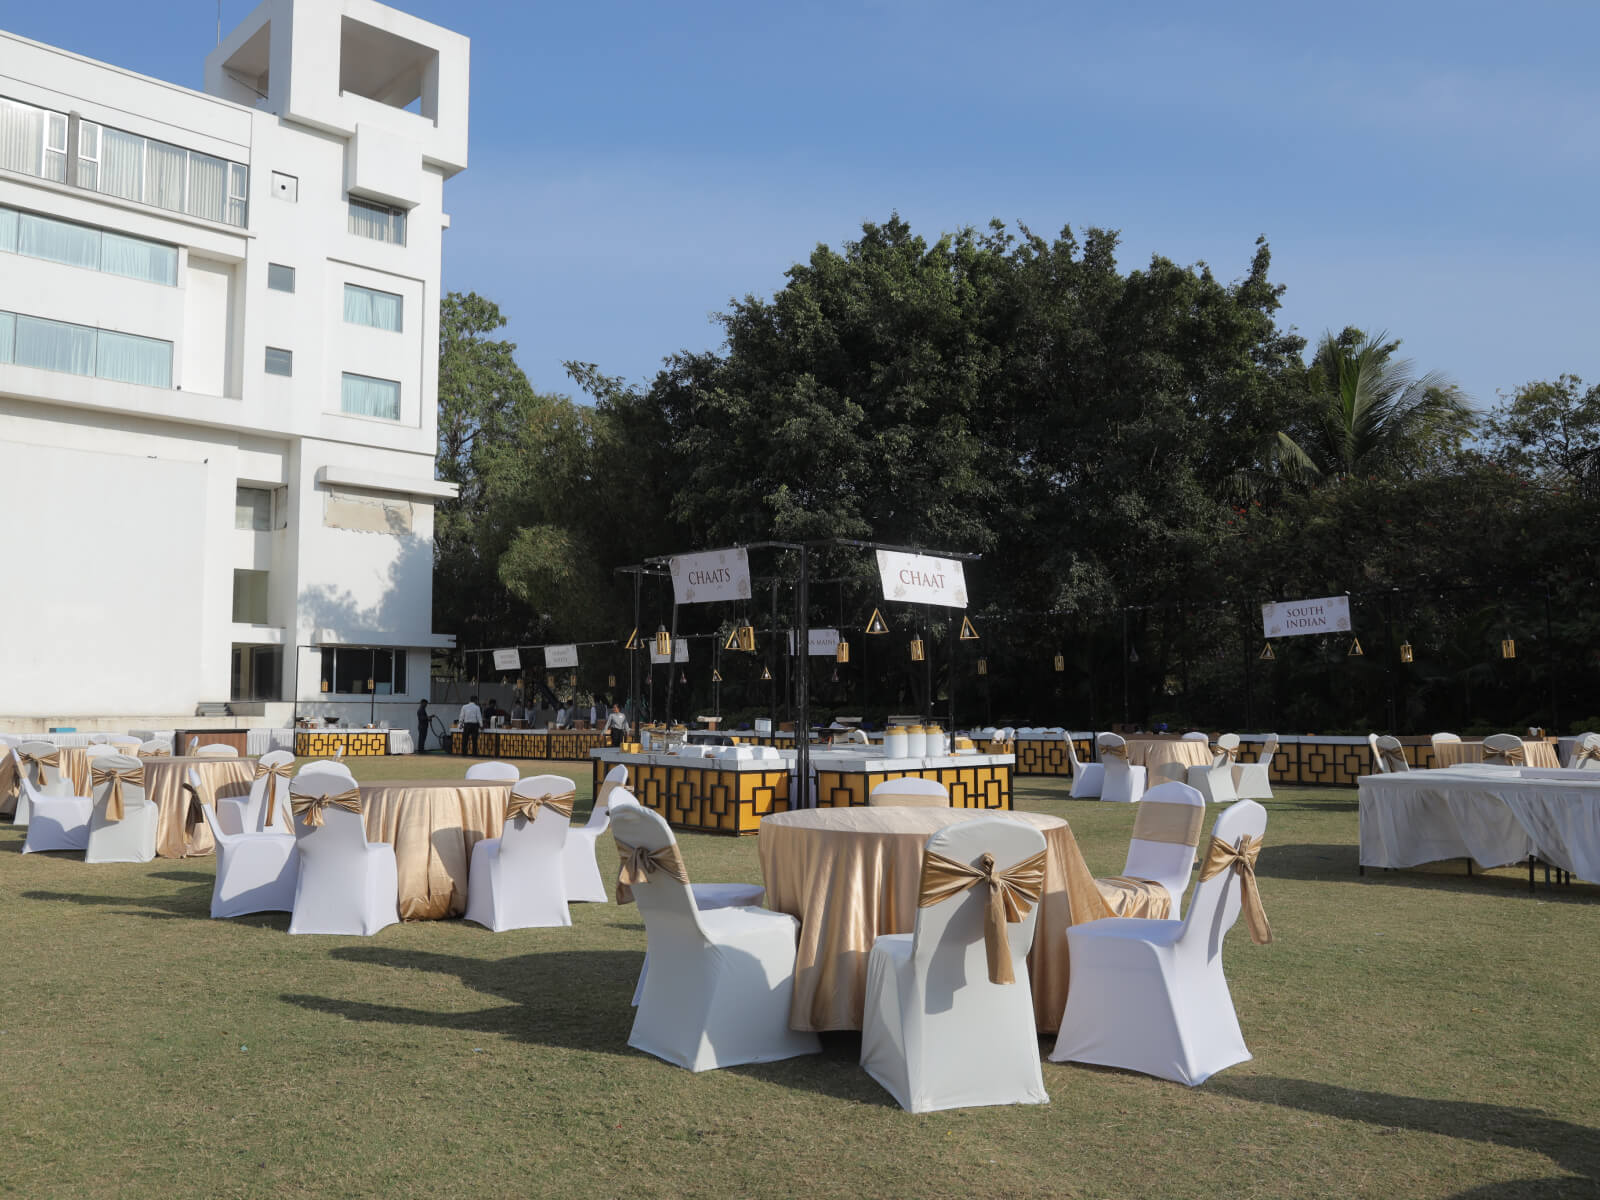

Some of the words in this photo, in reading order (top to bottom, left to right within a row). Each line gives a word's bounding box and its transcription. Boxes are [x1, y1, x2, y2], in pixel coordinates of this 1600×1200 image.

[688, 568, 731, 585] CHAATS
[899, 569, 945, 589] CHAAT
[1287, 606, 1324, 617] SOUTH
[1286, 616, 1326, 629] INDIAN
